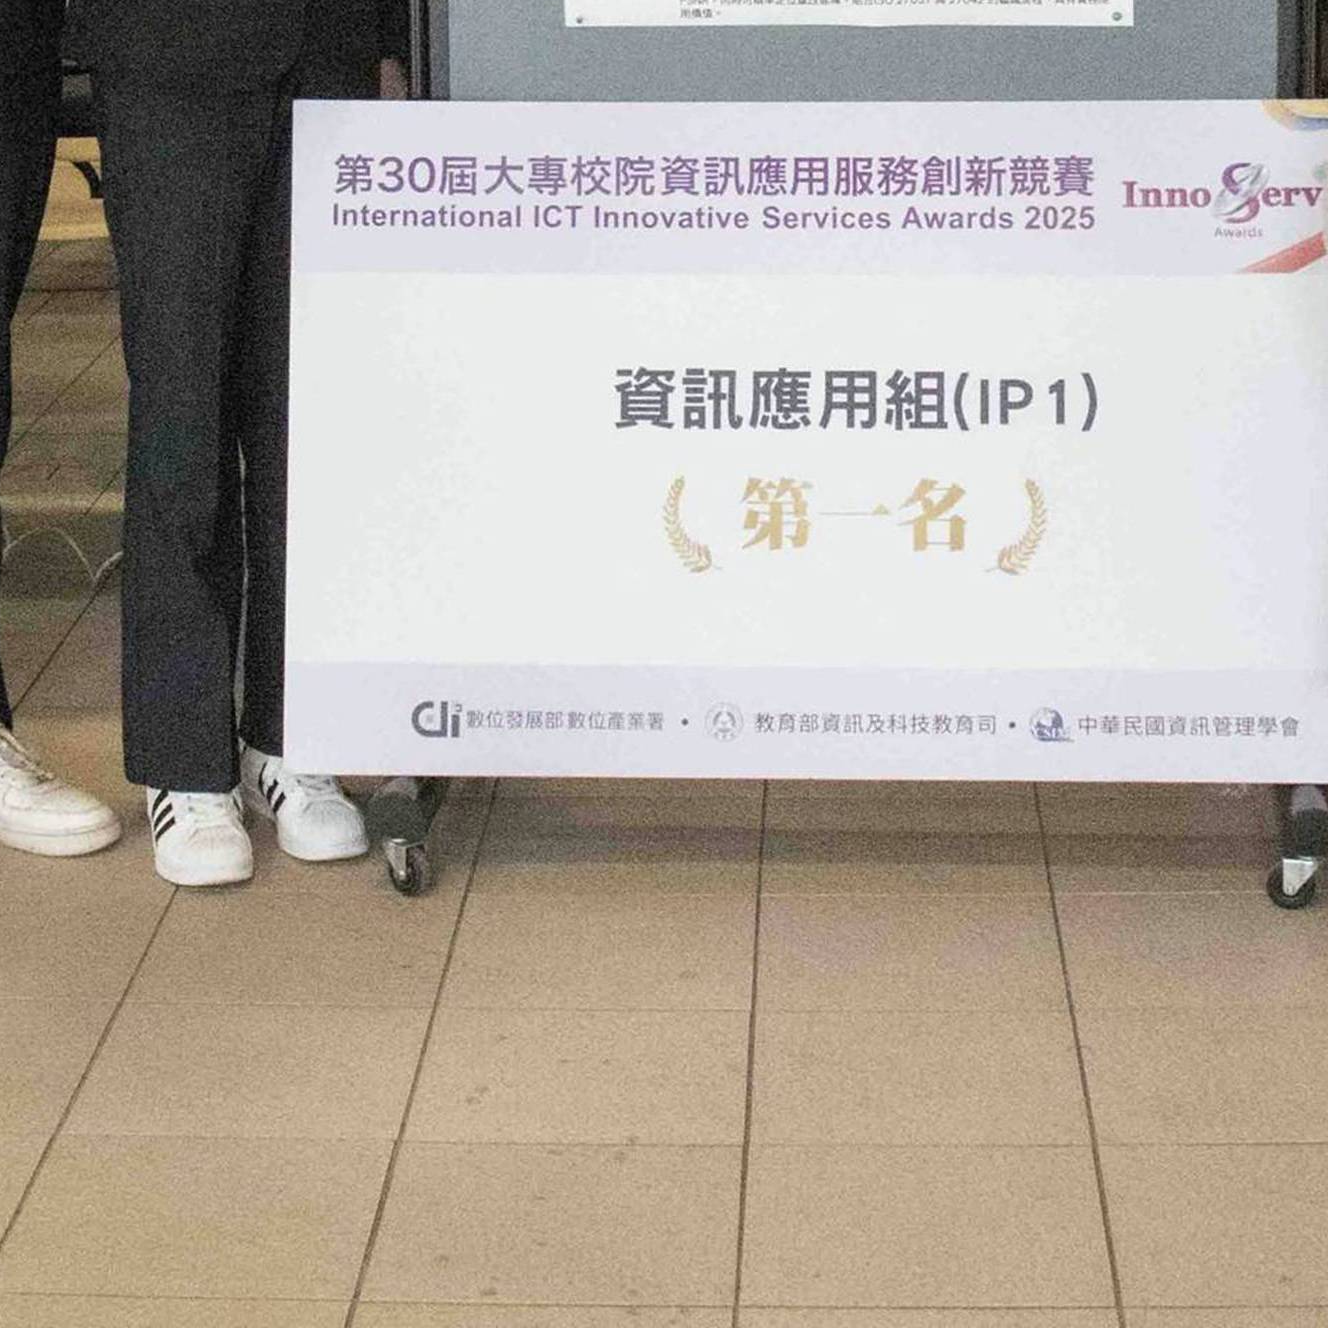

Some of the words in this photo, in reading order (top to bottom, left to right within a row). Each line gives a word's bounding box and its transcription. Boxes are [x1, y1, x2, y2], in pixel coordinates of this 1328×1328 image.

[332, 153, 1095, 199] 第30屆大專校院資訊應用服務創新競賽
[332, 203, 522, 229] International
[533, 204, 583, 229] ICT
[594, 205, 749, 230] Innovative
[762, 205, 891, 231] Services
[901, 206, 1014, 230] Awards
[1024, 205, 1096, 230] 2025
[1214, 226, 1264, 239] Awards
[613, 366, 1100, 435] 資訊應用組(IP1)
[738, 475, 971, 554] 第一名
[755, 713, 997, 735] 教育部資訊及科技教育司
[1077, 715, 1301, 738] 中華民國資訊管理學會
